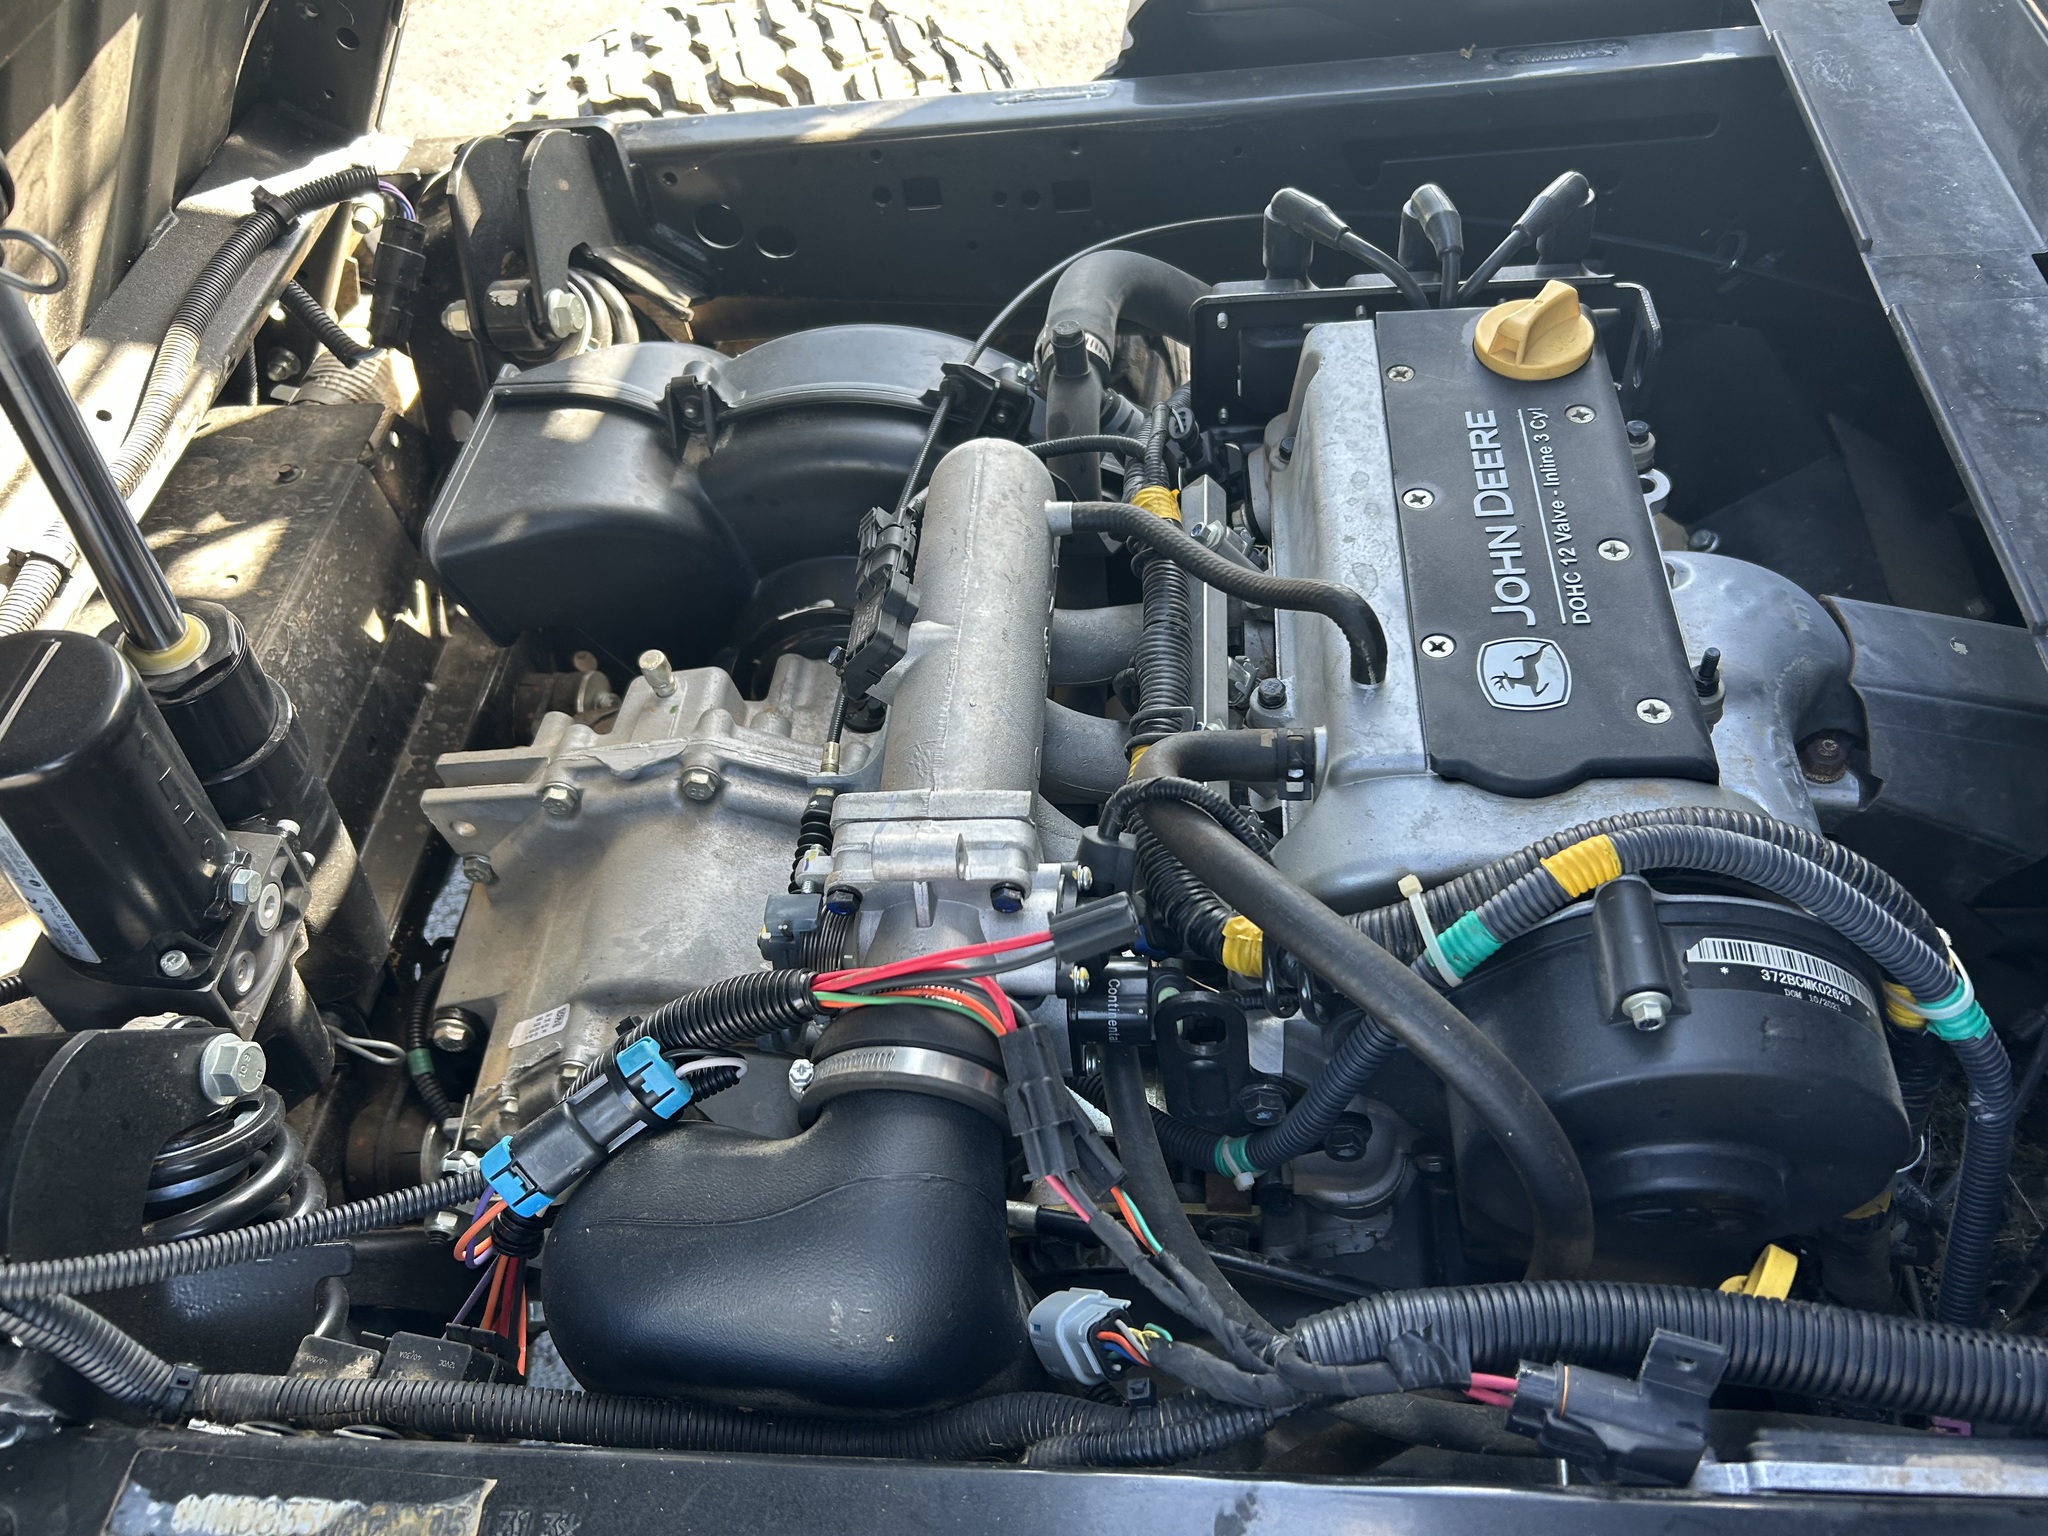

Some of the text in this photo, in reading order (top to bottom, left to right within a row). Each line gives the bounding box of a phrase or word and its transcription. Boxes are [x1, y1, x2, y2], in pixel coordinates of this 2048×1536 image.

[1527, 407, 1549, 431] Cyl
[1533, 433, 1550, 443] 3
[1539, 446, 1560, 487] Inline
[1464, 410, 1536, 626] JOHN DEERE
[1551, 500, 1573, 544] Valve
[1558, 548, 1578, 566] 12
[1564, 572, 1591, 624] DOHC
[1107, 978, 1121, 1043] Continental
